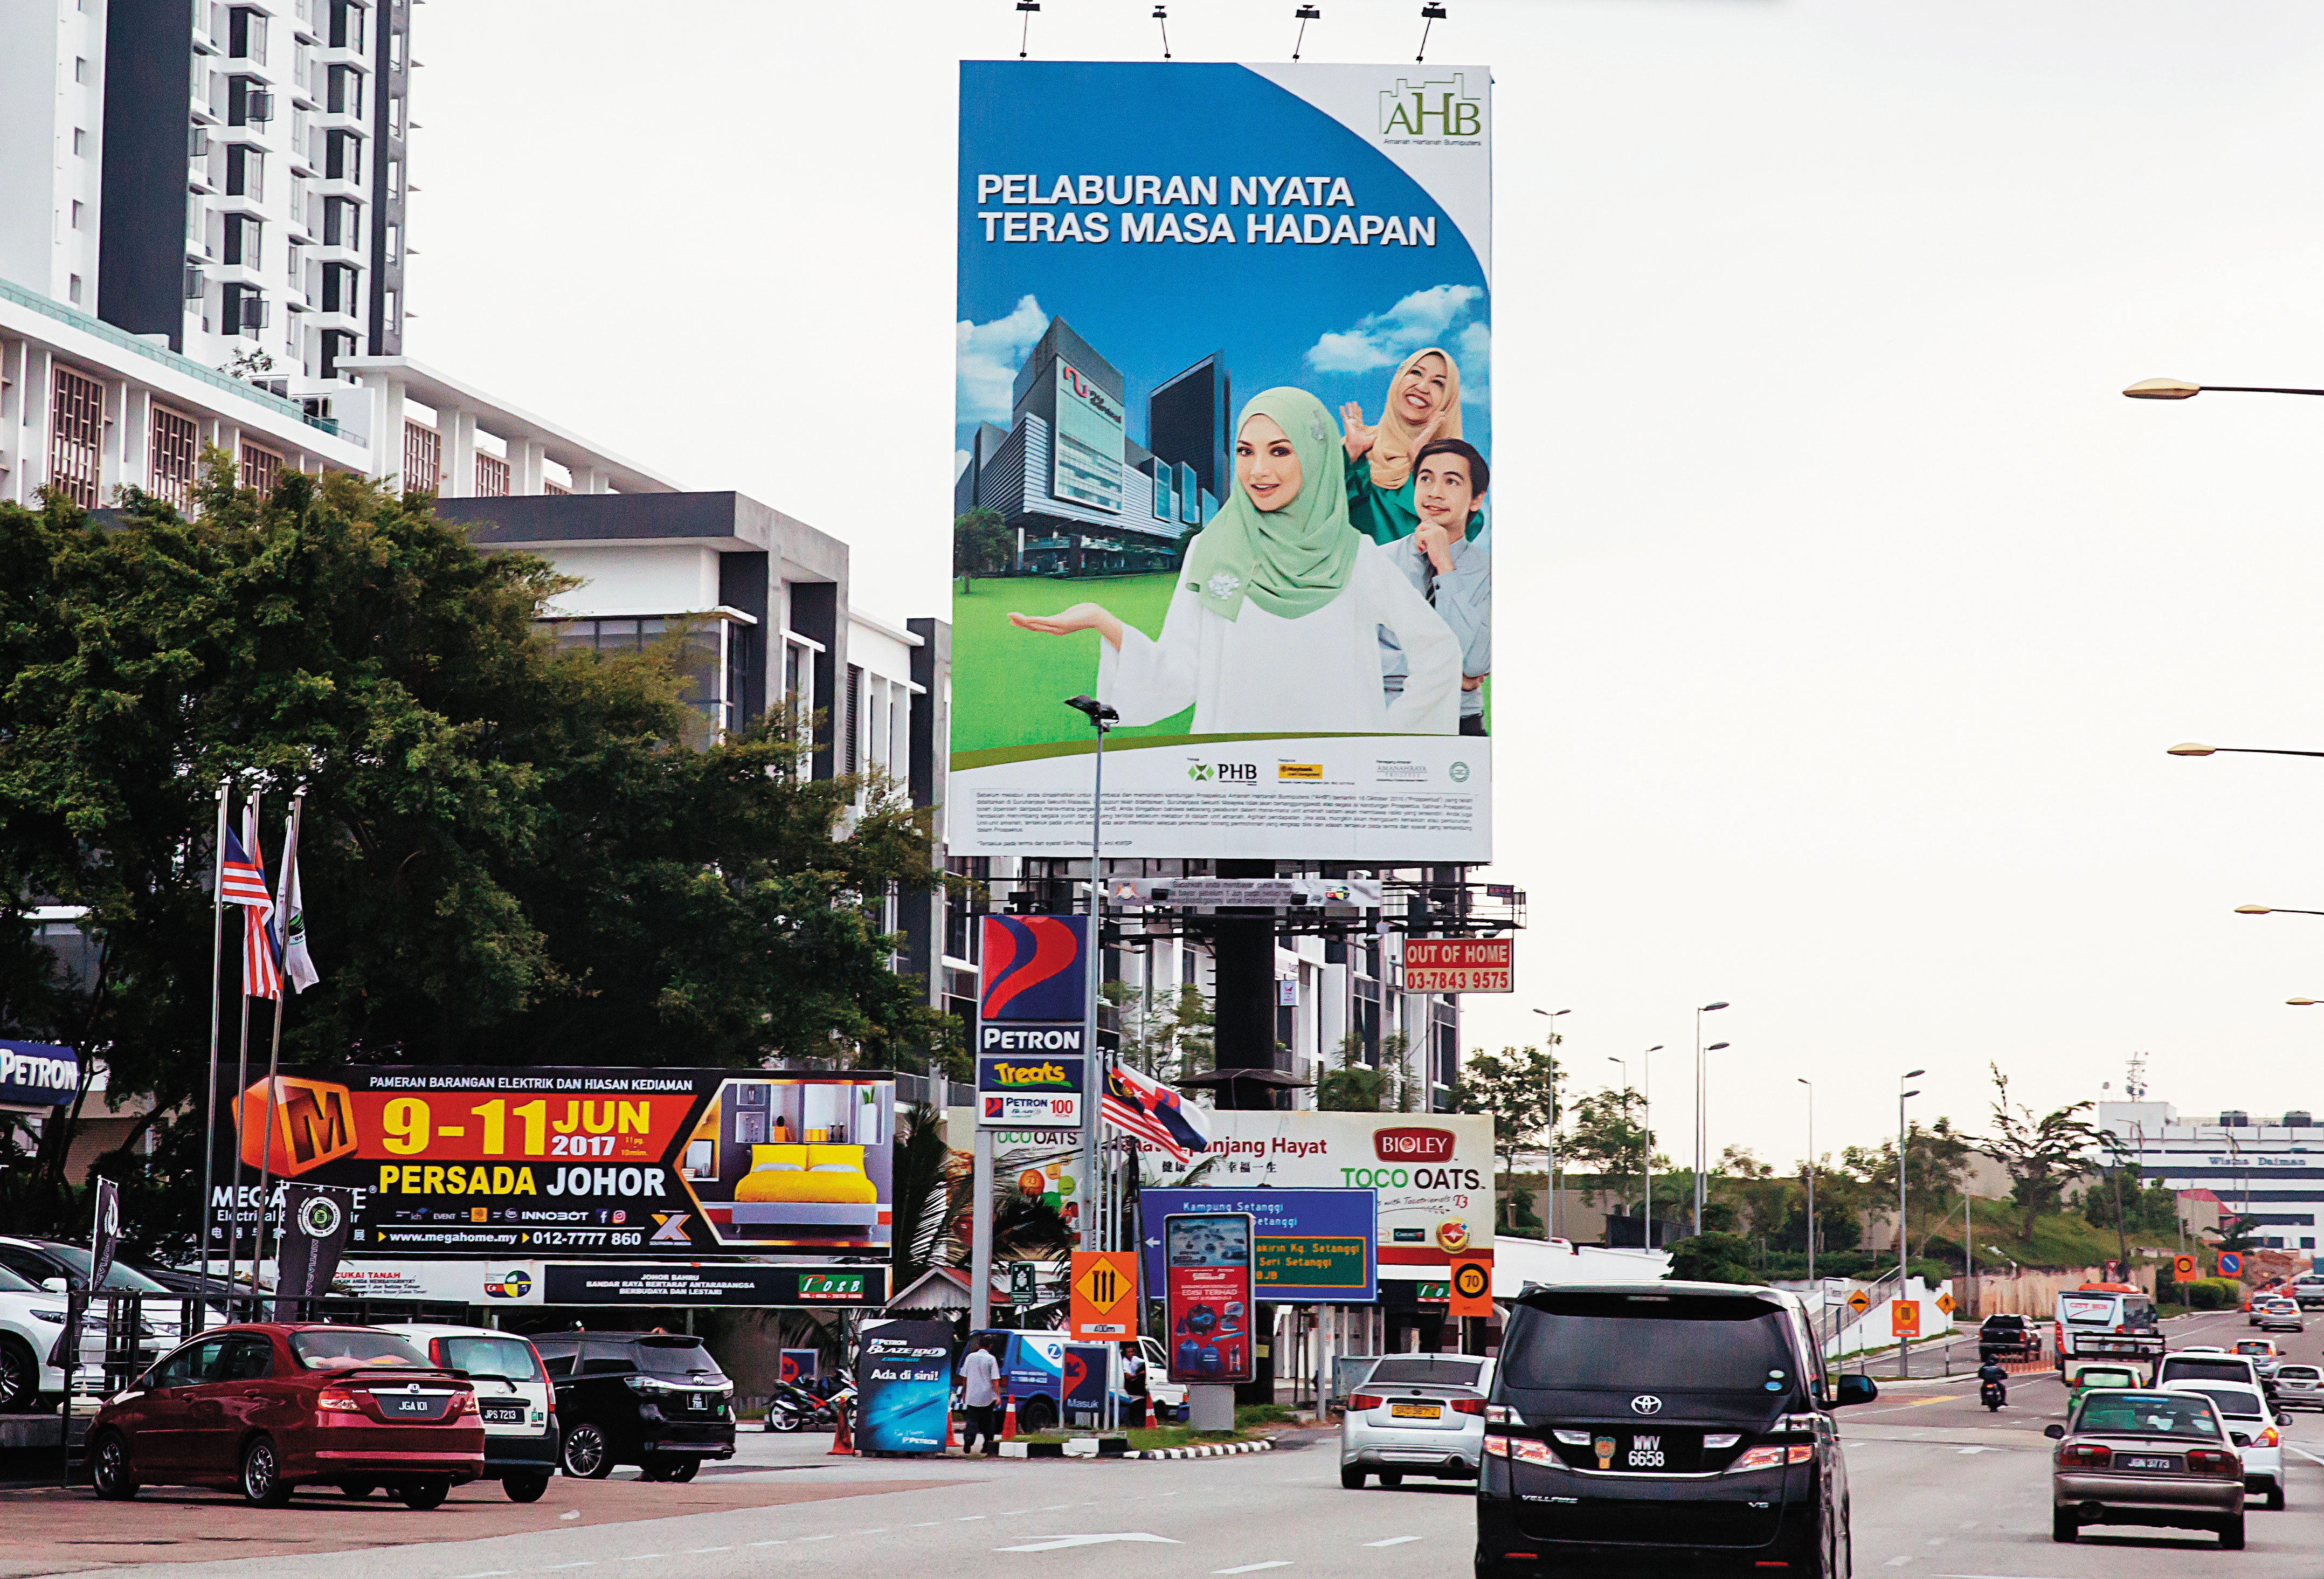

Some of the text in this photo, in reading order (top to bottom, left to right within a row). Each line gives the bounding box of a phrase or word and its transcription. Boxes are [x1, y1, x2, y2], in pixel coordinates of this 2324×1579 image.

[1384, 93, 1481, 135] AHB
[977, 174, 1354, 208] PELABURAN NYATA
[978, 211, 1436, 247] TERAS MASA HADAPAN
[1217, 764, 1257, 779] PHB
[1407, 945, 1508, 963] OUT OF HOME
[1407, 971, 1508, 989] 03-7843 9575
[984, 1028, 1080, 1050] PETRON
[0, 1049, 78, 1091] PETRON
[994, 1061, 1066, 1083] Treats
[370, 1077, 693, 1091] PAMERAN BARANGAN ELEKTRIK DAN HIASAN KEDIAMAN
[1006, 1097, 1074, 1114] PETRON 100
[552, 1100, 650, 1134] JUN
[551, 1135, 616, 1156] 2017
[997, 1132, 1078, 1145] OCO OATS
[1382, 1136, 1448, 1154] BIOLEY
[1272, 1137, 1327, 1158] Hayat
[2208, 1157, 2306, 1166] Wisma Daiman
[379, 1166, 666, 1197] PERSADA JOHOR
[1340, 1168, 1479, 1190] TOCO OATS
[211, 1185, 287, 1208] MEGA
[1183, 1202, 1284, 1214] Kampung Setanggi
[390, 1231, 642, 1246] www.megahome.my 012-7777 860
[1312, 1243, 1360, 1254] Setanggi
[1285, 1257, 1332, 1269] Setanggi
[1464, 1275, 1480, 1287] 70
[870, 1369, 939, 1381] Ada di sini!
[398, 1401, 427, 1411] JGA 101
[1067, 1398, 1099, 1409] Masuk
[484, 1410, 516, 1419] JPS 7213
[1628, 1450, 1665, 1467] 6658
